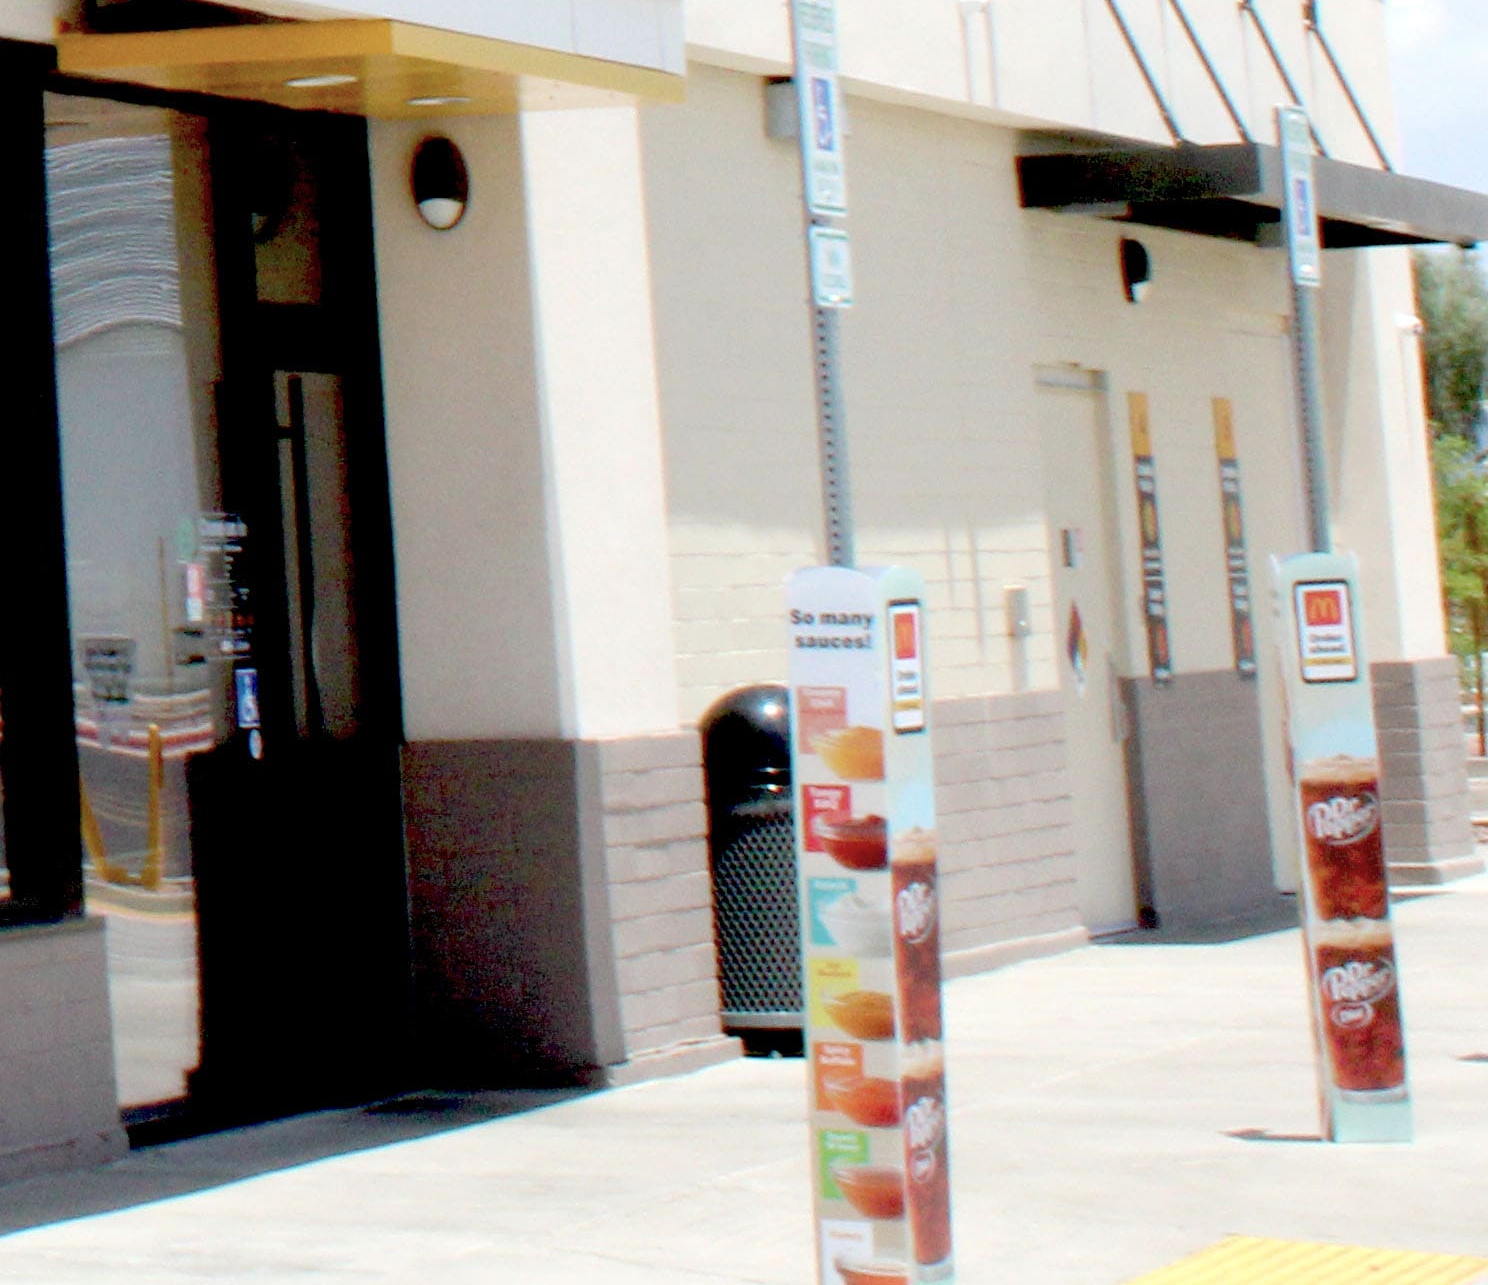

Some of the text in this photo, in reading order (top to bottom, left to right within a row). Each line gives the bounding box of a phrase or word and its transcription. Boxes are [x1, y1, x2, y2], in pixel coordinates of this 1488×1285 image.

[789, 607, 875, 630] So many
[794, 632, 872, 649] sauces!
